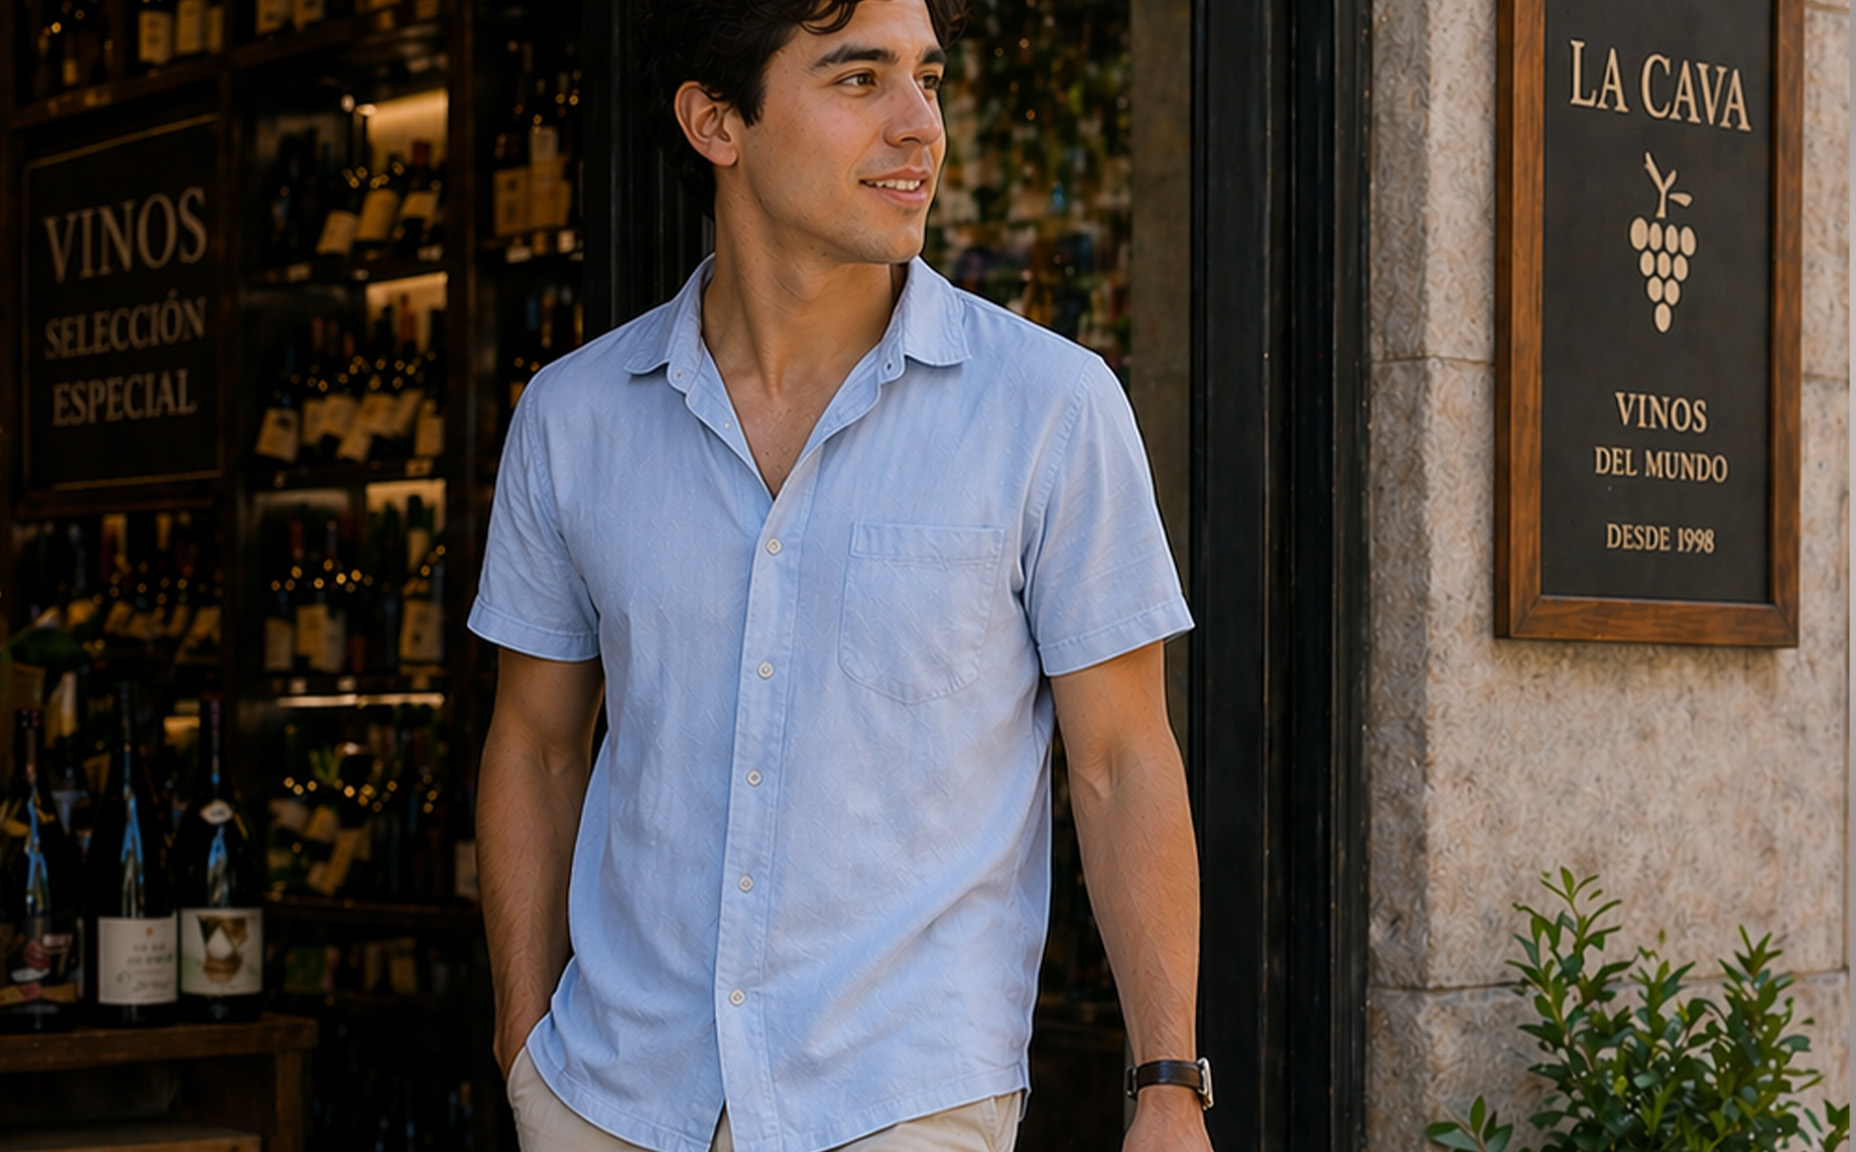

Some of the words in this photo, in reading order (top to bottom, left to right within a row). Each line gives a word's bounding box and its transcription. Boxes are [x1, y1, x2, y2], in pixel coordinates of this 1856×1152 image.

[1569, 39, 1629, 112] LA
[1641, 53, 1752, 132] CAVA
[43, 186, 208, 283] VINOS
[43, 289, 207, 361] SELECCIÓN
[52, 368, 198, 428] ESPECIAL
[1615, 392, 1708, 434] VINOS
[1594, 446, 1638, 477] DEL
[1644, 450, 1728, 483] MUNDO
[1606, 523, 1671, 553] DESDE
[1676, 527, 1715, 554] 1998
